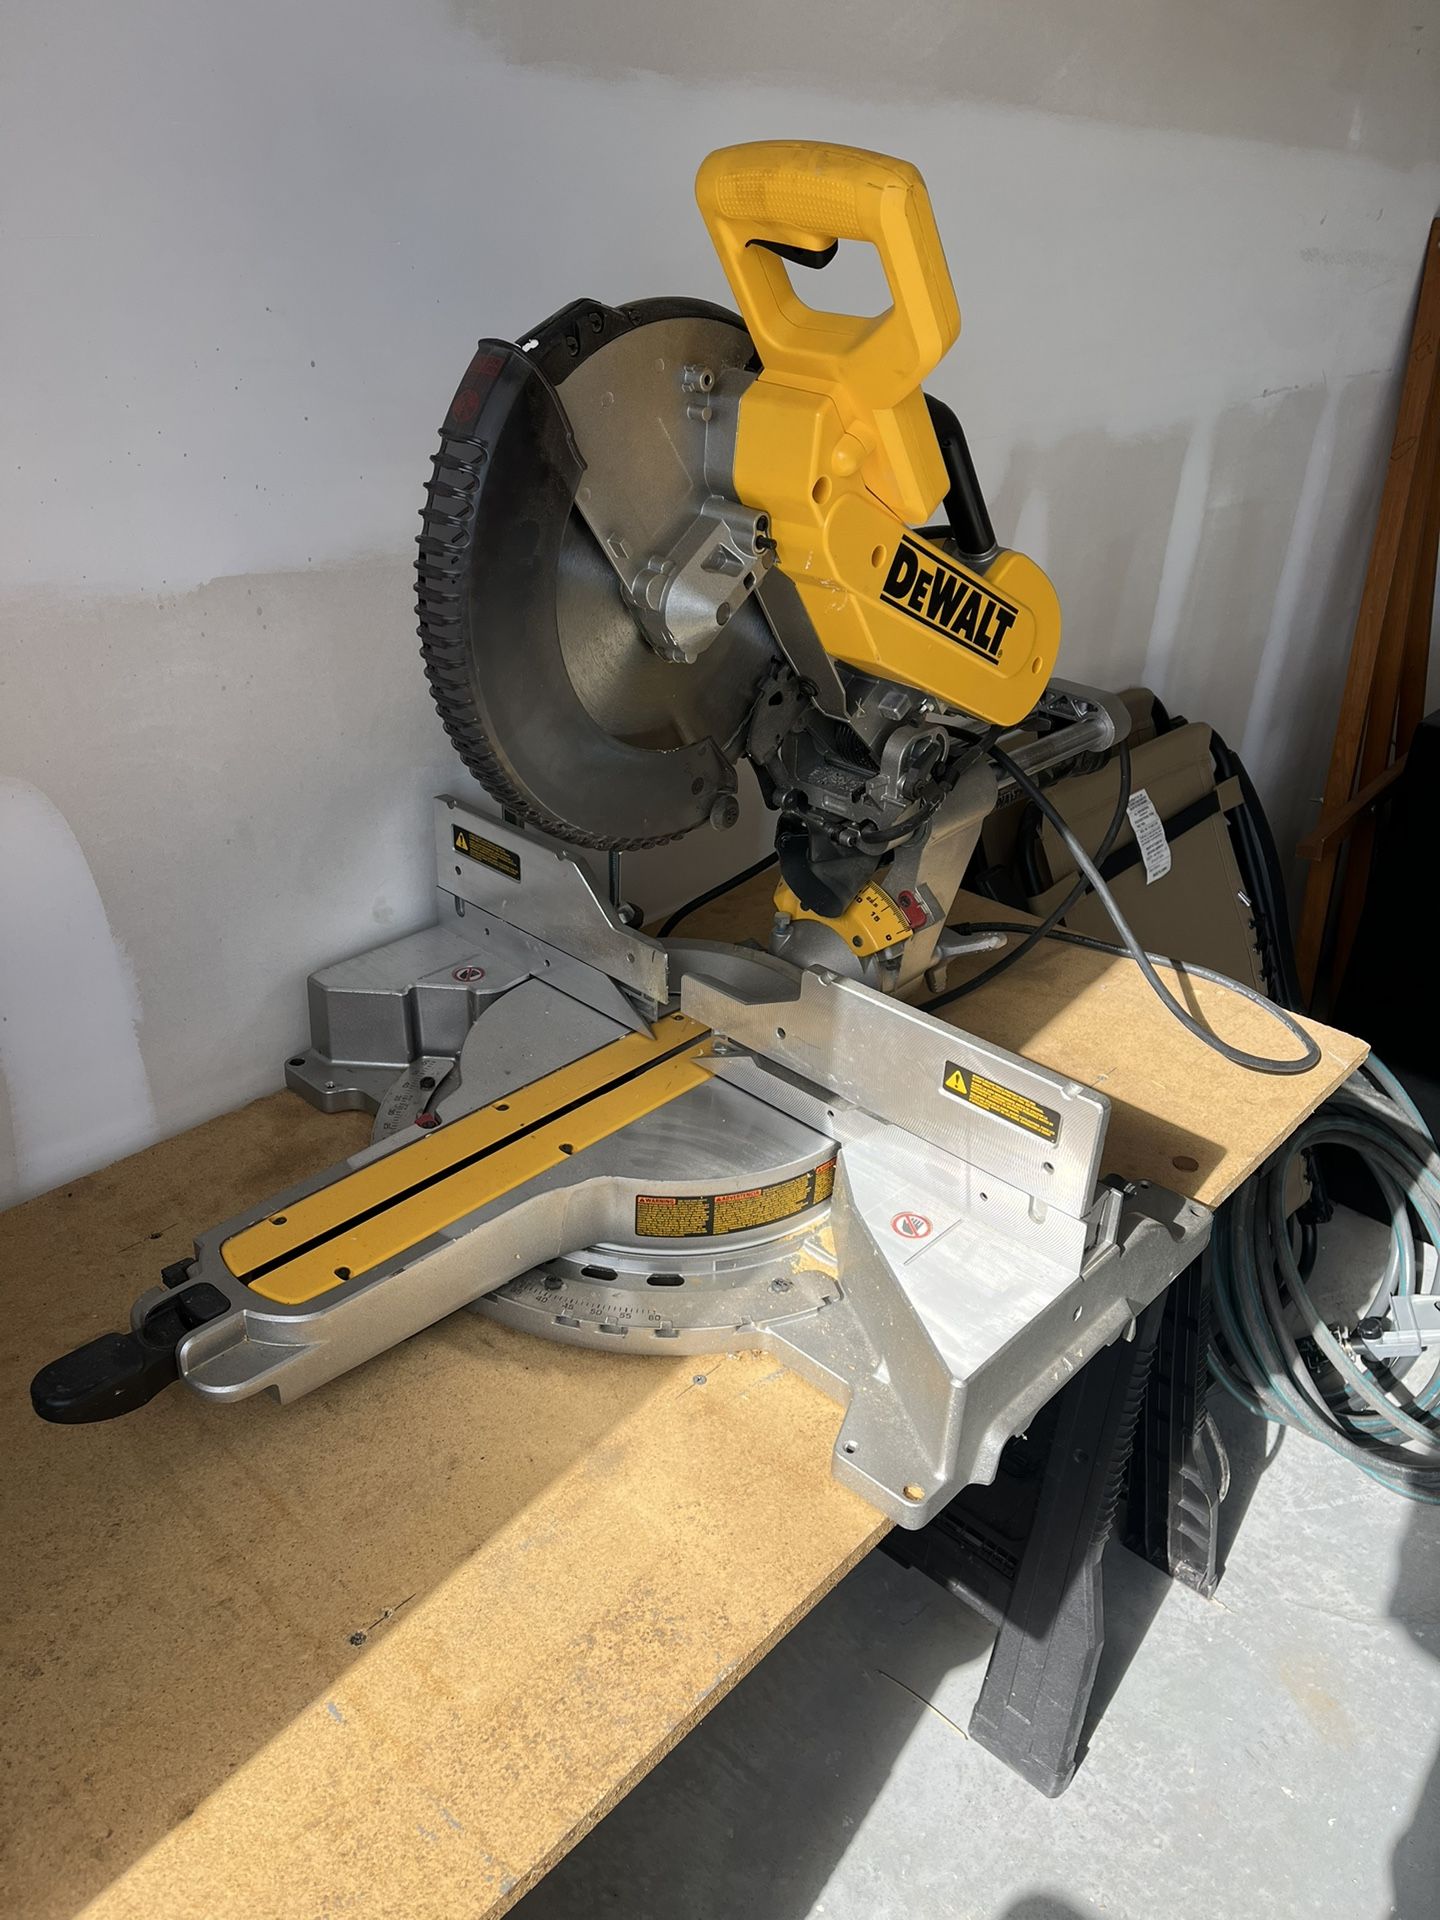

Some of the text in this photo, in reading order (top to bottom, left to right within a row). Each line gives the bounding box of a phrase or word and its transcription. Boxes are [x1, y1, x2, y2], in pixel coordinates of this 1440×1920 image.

[870, 911, 880, 922] 15
[535, 1295, 548, 1303] 40
[590, 1308, 603, 1316] 50
[620, 1312, 632, 1320] 55
